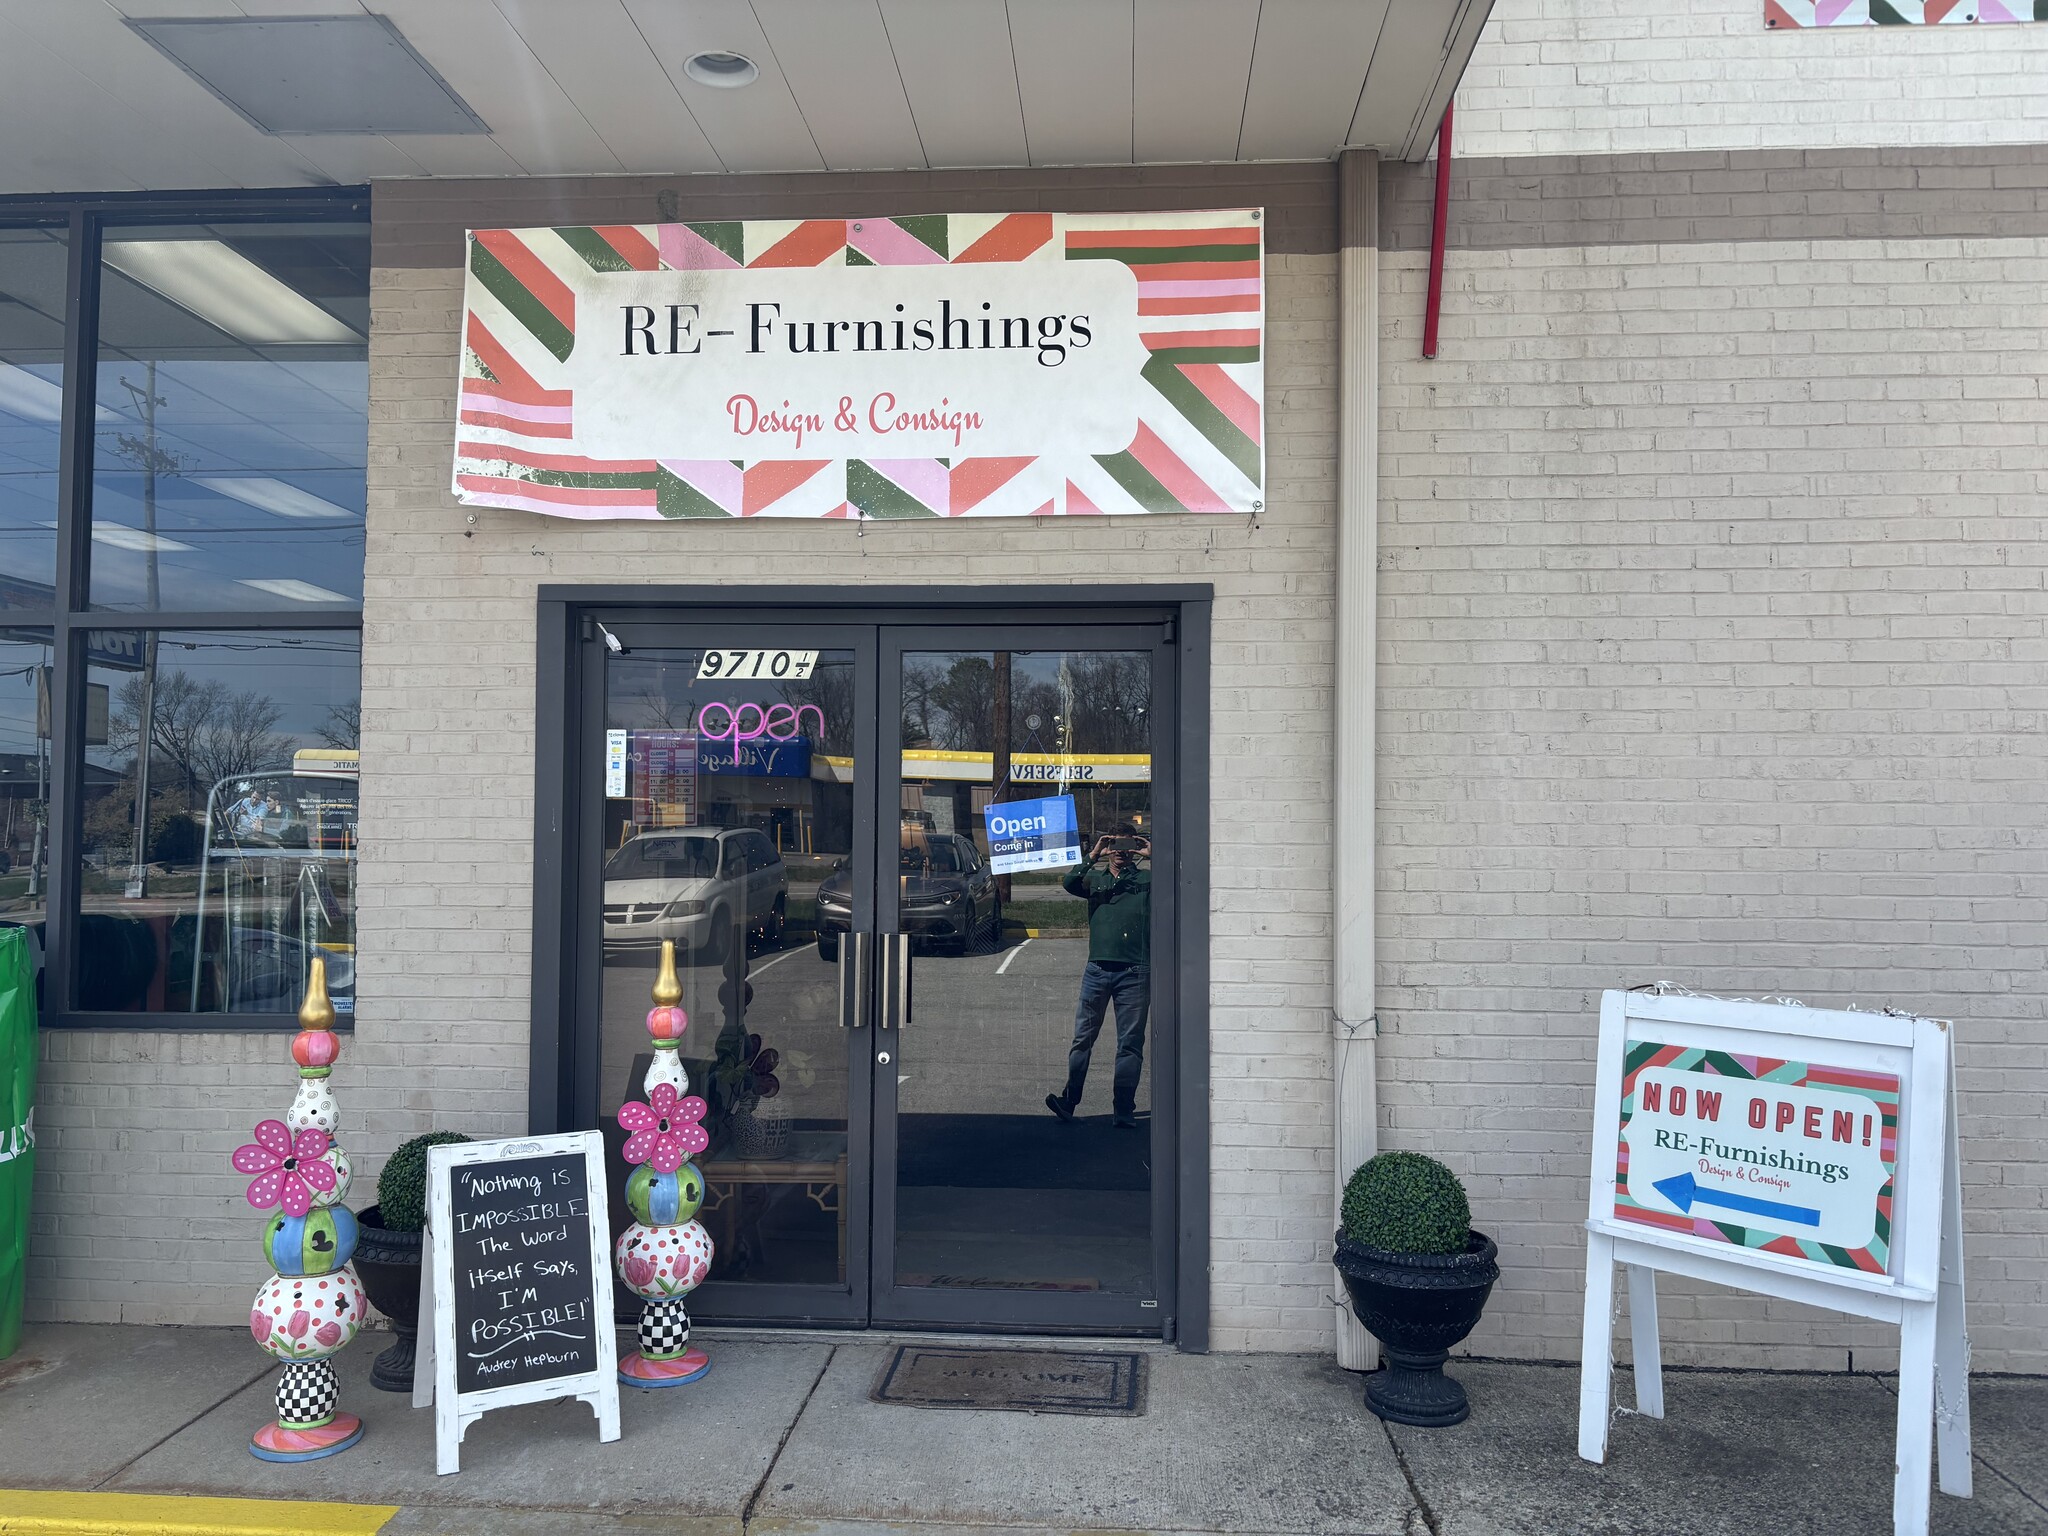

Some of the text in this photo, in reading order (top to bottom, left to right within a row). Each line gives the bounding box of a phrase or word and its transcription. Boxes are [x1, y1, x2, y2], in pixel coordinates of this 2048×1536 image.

[726, 391, 984, 450] Design & Consign
[698, 701, 825, 768] open
[990, 815, 1047, 837] Open
[994, 842, 1022, 852] Come
[1642, 1081, 1873, 1147] NOW OPEN!
[1654, 1128, 1850, 1183] RE-Furnishings
[1698, 1158, 1792, 1192] Design & Consign
[476, 1236, 513, 1256] The
[468, 1261, 524, 1289] itself
[476, 1350, 580, 1376] Audrey Hepburn
